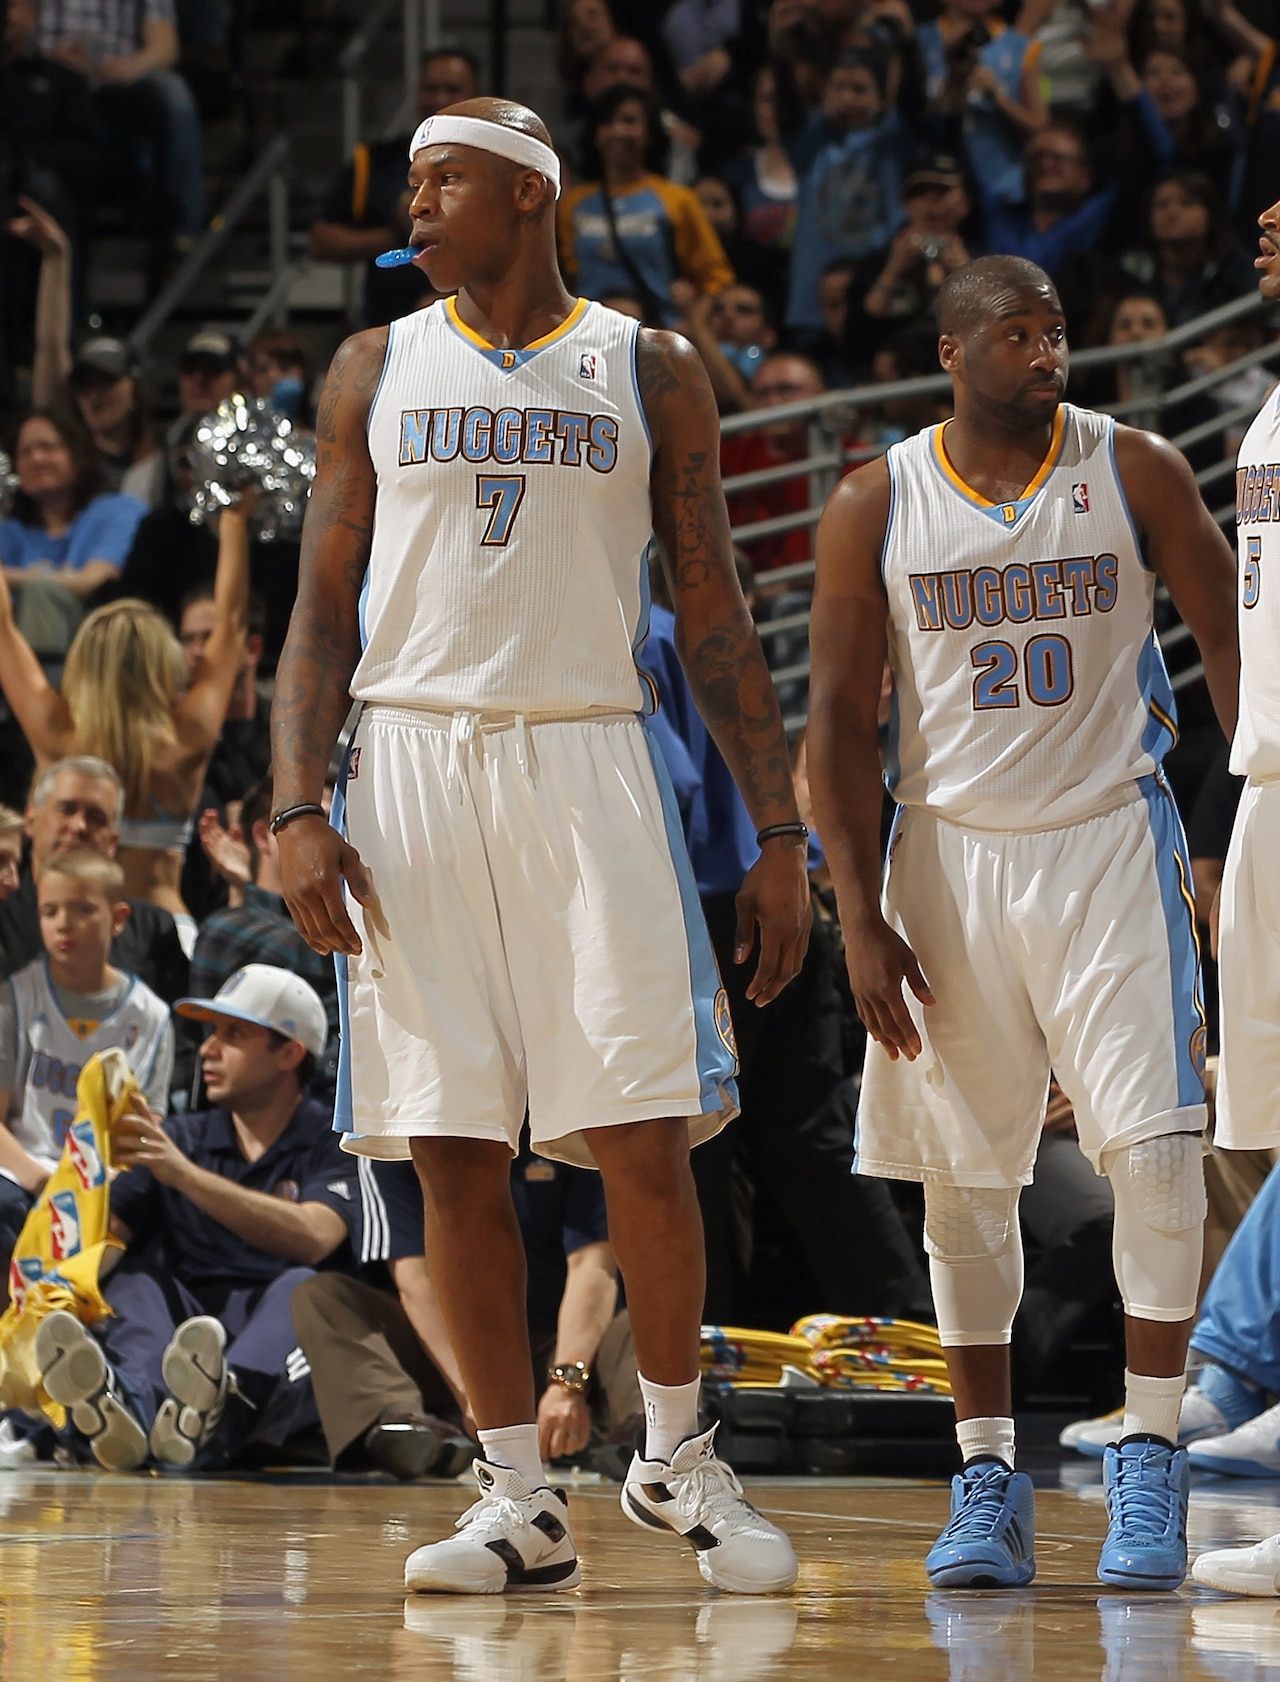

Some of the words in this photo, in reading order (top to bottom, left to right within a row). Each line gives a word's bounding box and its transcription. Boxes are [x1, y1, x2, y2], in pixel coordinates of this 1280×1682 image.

[399, 406, 618, 473] NUGGETS
[476, 474, 526, 546] 7
[909, 553, 1119, 631] NUGGETS
[1243, 536, 1261, 609] 5
[970, 633, 1075, 711] 20
